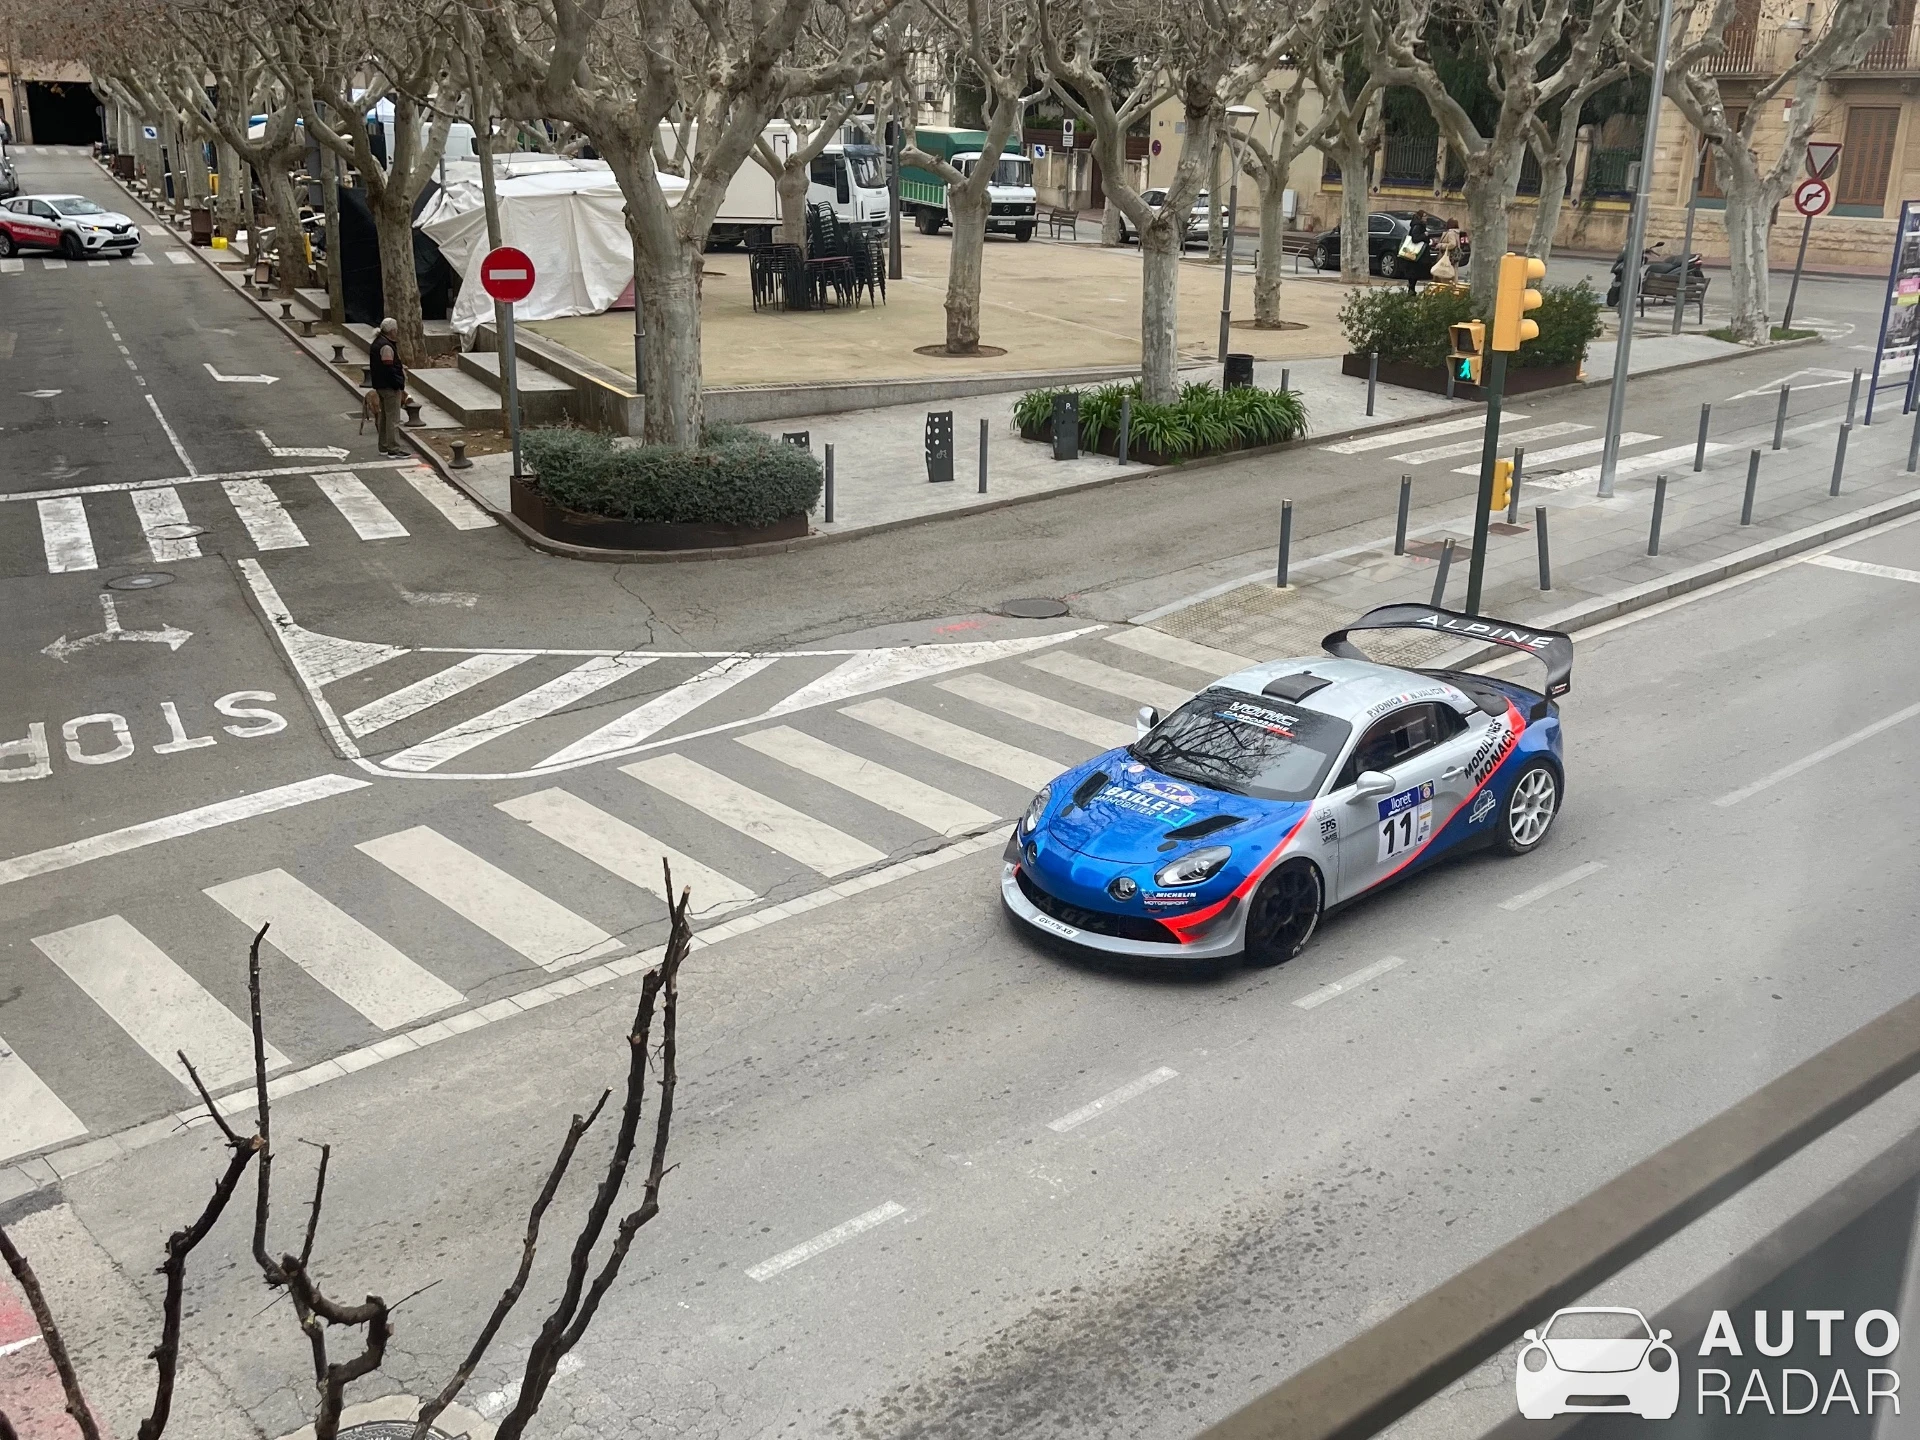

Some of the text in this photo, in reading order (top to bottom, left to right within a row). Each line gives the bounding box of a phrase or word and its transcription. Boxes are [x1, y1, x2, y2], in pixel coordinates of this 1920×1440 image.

[1416, 615, 1554, 648] ALPINE
[0, 690, 288, 783] STOP
[1464, 718, 1503, 779] MODULAIRES
[1474, 729, 1516, 787] MONACO
[1096, 794, 1156, 816] IMMOBILIER
[1104, 786, 1181, 814] BAILLET
[1390, 792, 1412, 810] lloret
[1320, 818, 1337, 834] EPS
[1383, 811, 1412, 855] 11
